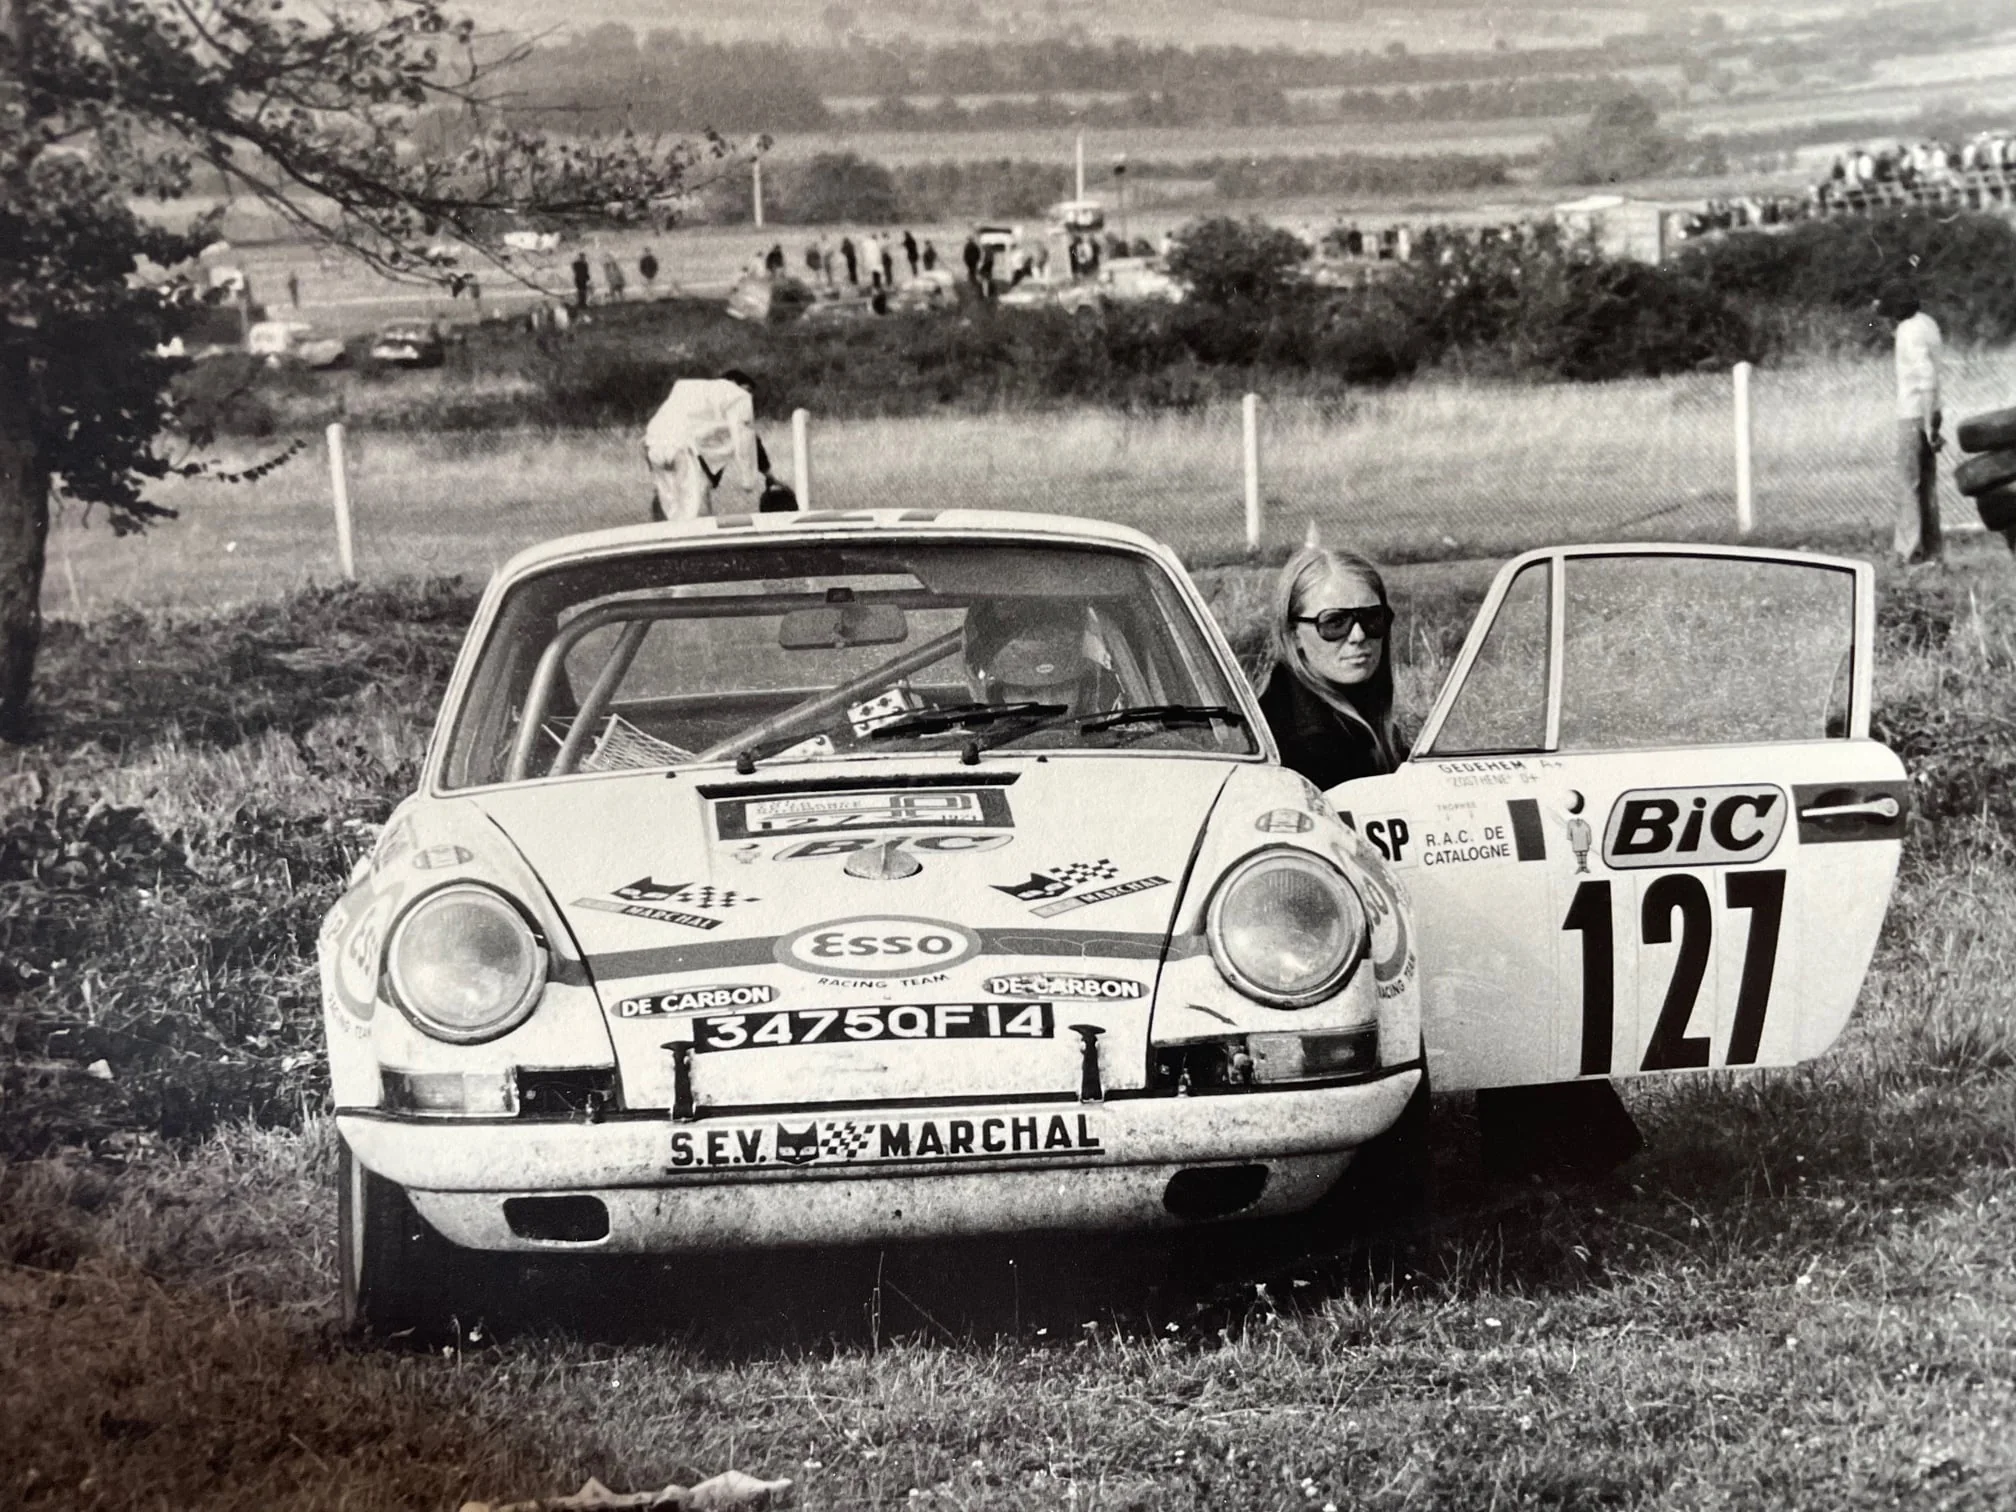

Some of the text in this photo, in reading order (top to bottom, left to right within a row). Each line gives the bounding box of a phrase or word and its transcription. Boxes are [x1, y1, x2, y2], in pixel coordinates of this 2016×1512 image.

[1426, 826, 1505, 848] R.A.C. DE
[1423, 843, 1511, 866] CATALOGNE
[1078, 877, 1165, 904] MARCHAL
[626, 905, 714, 929] MARCHAL
[817, 974, 950, 989] RACING TEAM
[1561, 869, 1787, 1076] 127
[990, 978, 1141, 998] DE CARBON
[621, 985, 771, 1017] DE CARBON
[671, 1114, 1101, 1167] S.E.V. MARCHAL
